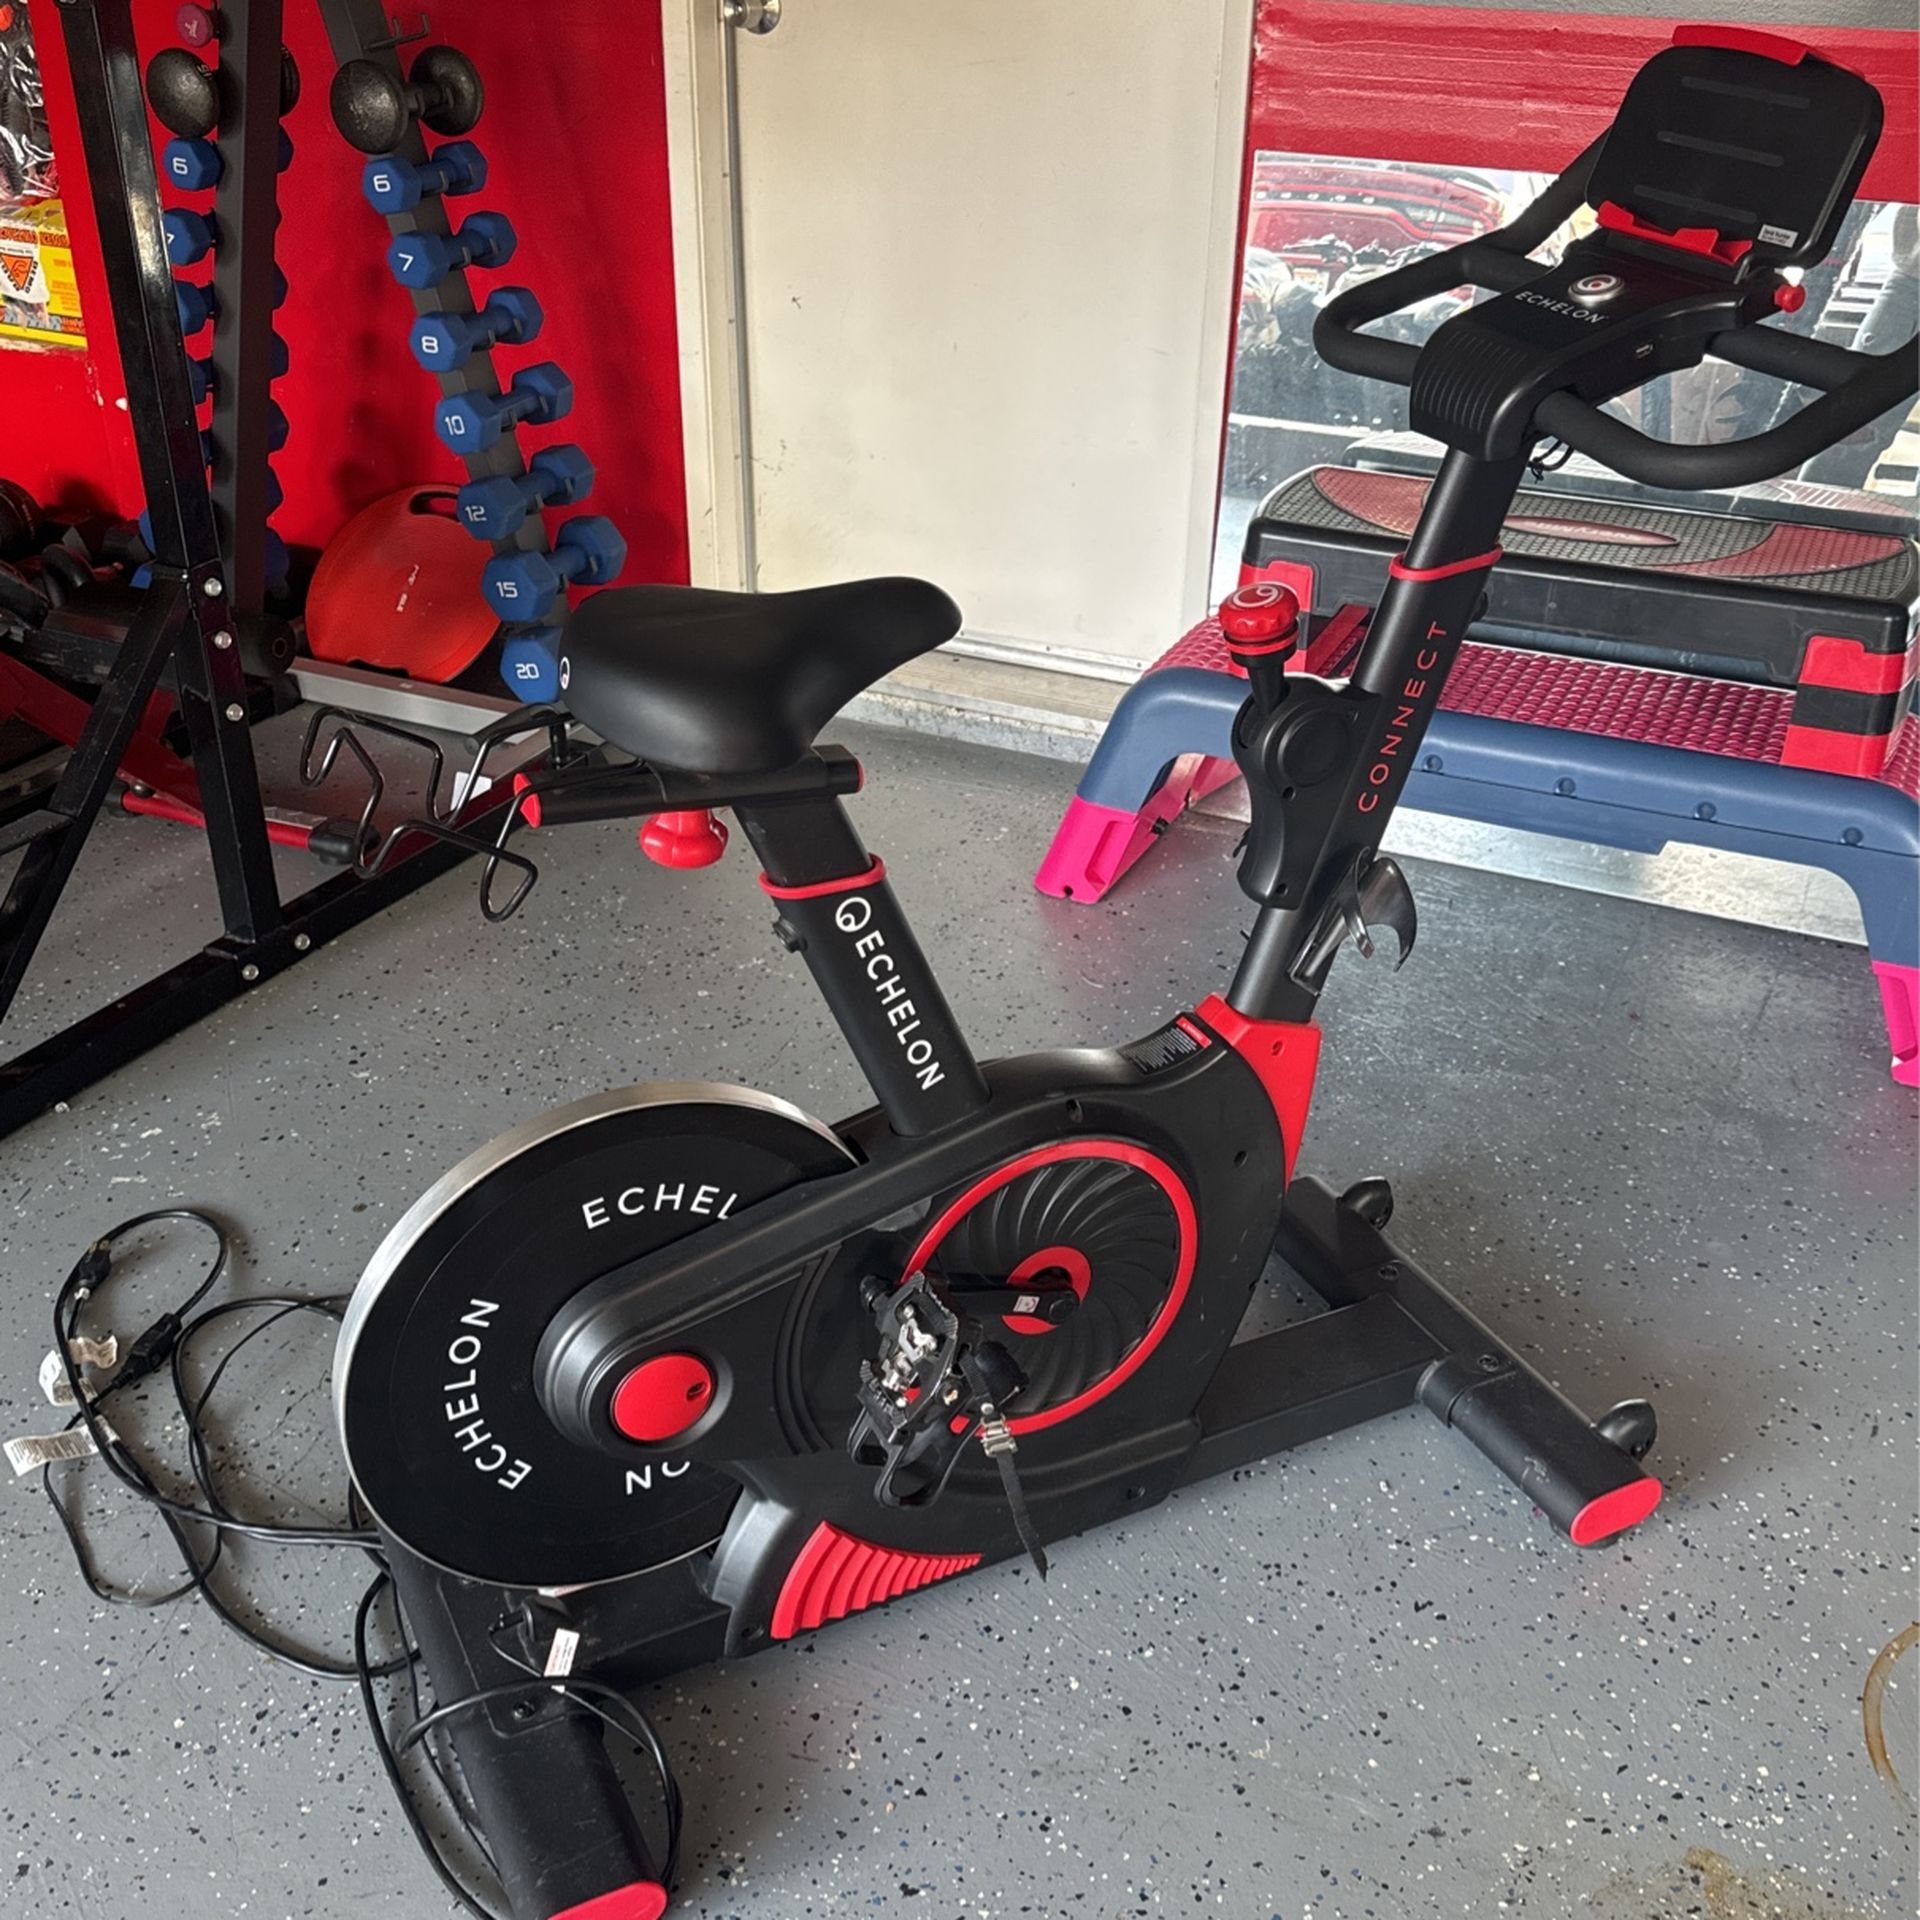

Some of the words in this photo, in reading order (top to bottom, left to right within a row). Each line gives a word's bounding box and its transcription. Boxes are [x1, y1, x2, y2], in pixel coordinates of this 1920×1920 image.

[172, 157, 188, 175] 6
[373, 174, 391, 192] 6
[398, 253, 414, 271] 7
[1514, 290, 1605, 323] ECHELON
[421, 336, 438, 354] 8
[445, 415, 465, 435] 10
[465, 505, 487, 522] 12
[496, 581, 518, 598] 15
[515, 663, 540, 679] 20
[1358, 621, 1447, 812] CONNECT
[855, 930, 945, 1091] ECHELON
[444, 1299, 532, 1490] ECHELON
